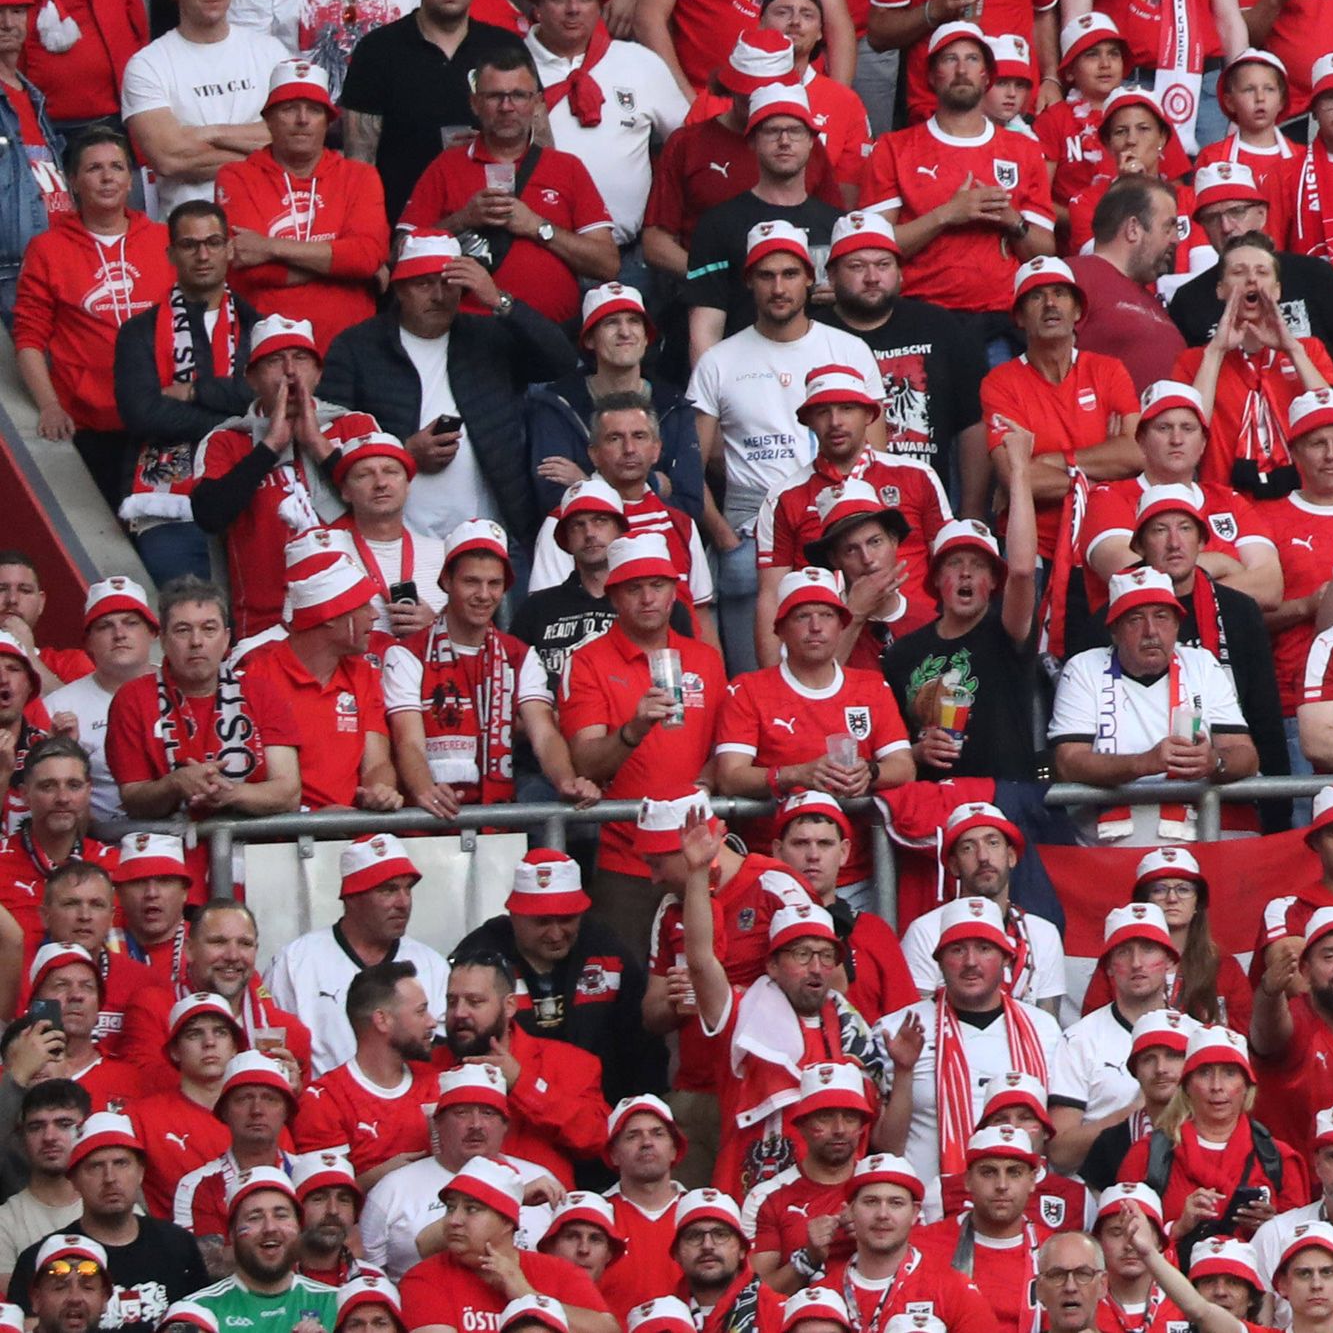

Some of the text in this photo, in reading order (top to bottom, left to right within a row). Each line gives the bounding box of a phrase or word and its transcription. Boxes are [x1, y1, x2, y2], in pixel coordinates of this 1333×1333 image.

[193, 78, 256, 97] VIVA C.U.
[743, 435, 797, 449] MEISTER
[746, 450, 795, 464] 2022/23
[543, 621, 578, 640] READY
[583, 618, 596, 635] TO
